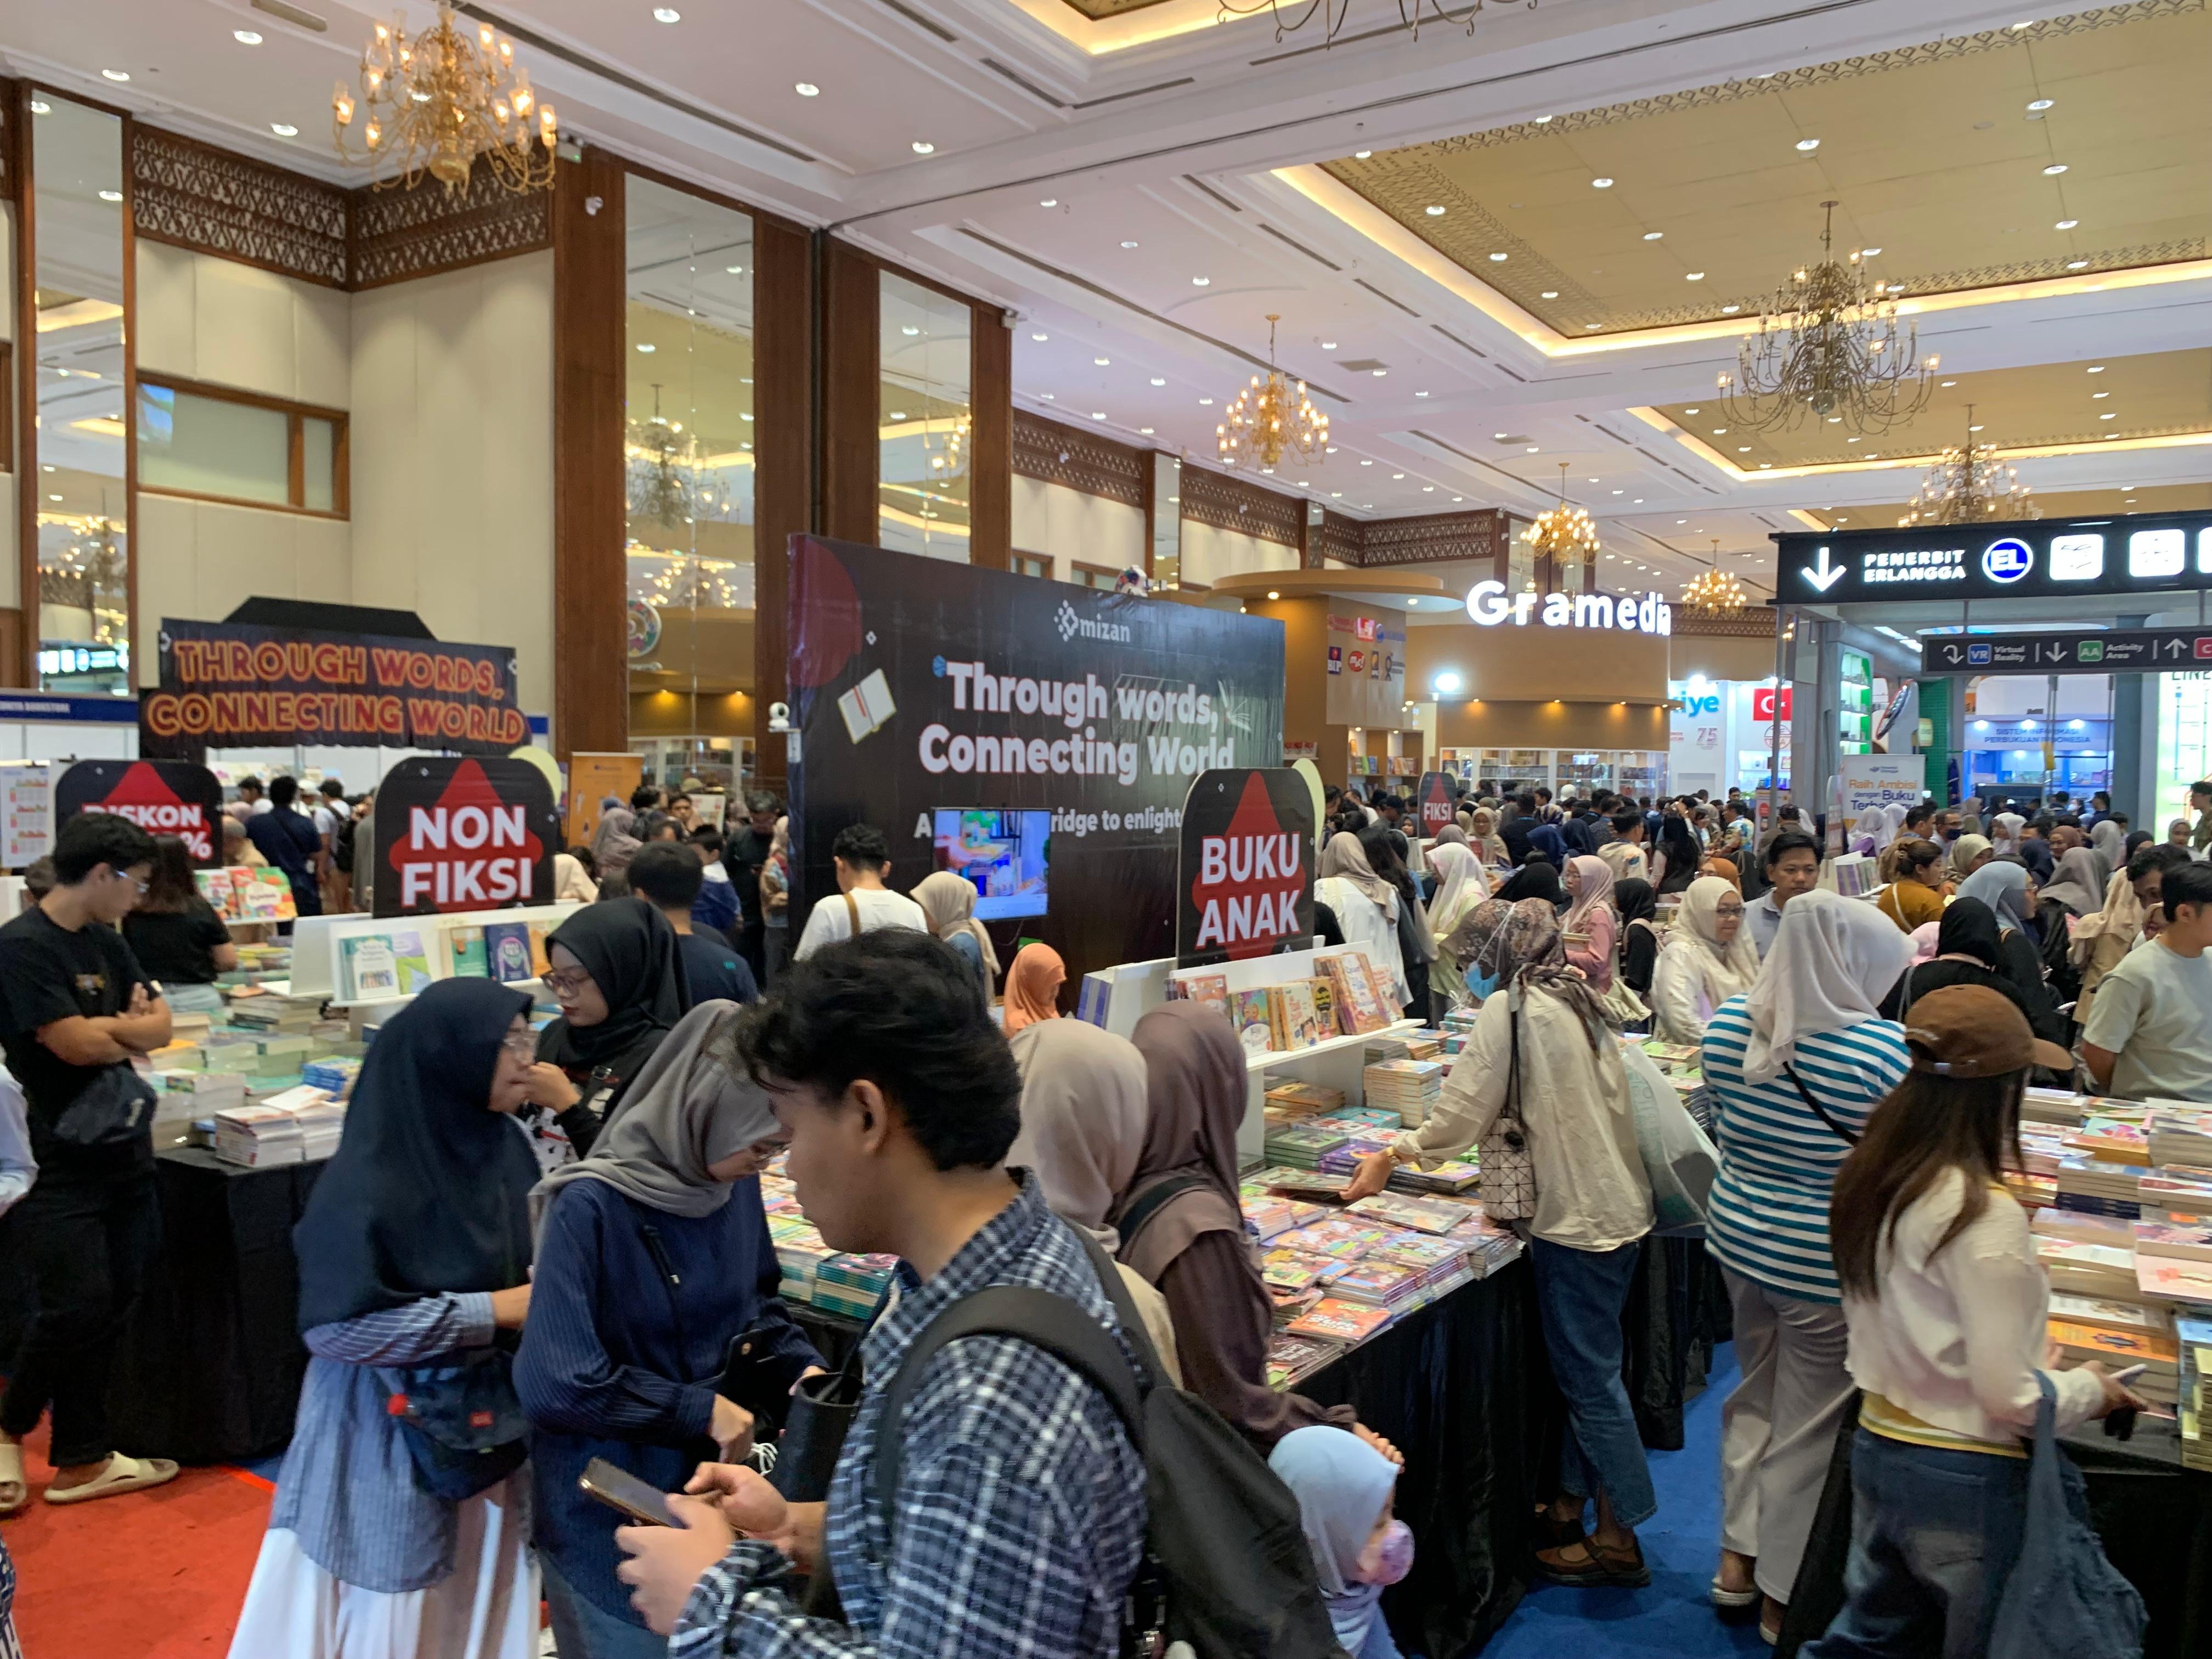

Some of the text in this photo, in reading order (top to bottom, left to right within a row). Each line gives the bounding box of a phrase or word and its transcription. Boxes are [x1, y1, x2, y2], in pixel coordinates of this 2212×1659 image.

[1864, 566, 1966, 582] ERLANGGA
[1865, 550, 1965, 567] PENERBIT
[1991, 549, 2025, 571] EL
[1466, 580, 1671, 636] Gramedia
[1080, 613, 1131, 642] mizan
[174, 640, 367, 685] THROUGH
[1971, 651, 1988, 659] VR
[2080, 648, 2099, 657] AA
[945, 661, 1219, 733] Through words,
[146, 692, 525, 744] CONNECTING WORLD
[918, 723, 1236, 787] Connecting World
[1423, 802, 1452, 821] FIKSI
[1882, 790, 1915, 800] Buku
[84, 805, 201, 827] SKON
[411, 805, 525, 850] NON
[1050, 806, 1097, 838] ridge
[1102, 810, 1119, 831] to
[1124, 805, 1182, 833] enlight
[1201, 833, 1300, 885] BUKU
[403, 857, 532, 906] FIKSI
[1197, 889, 1301, 946] ANAK
